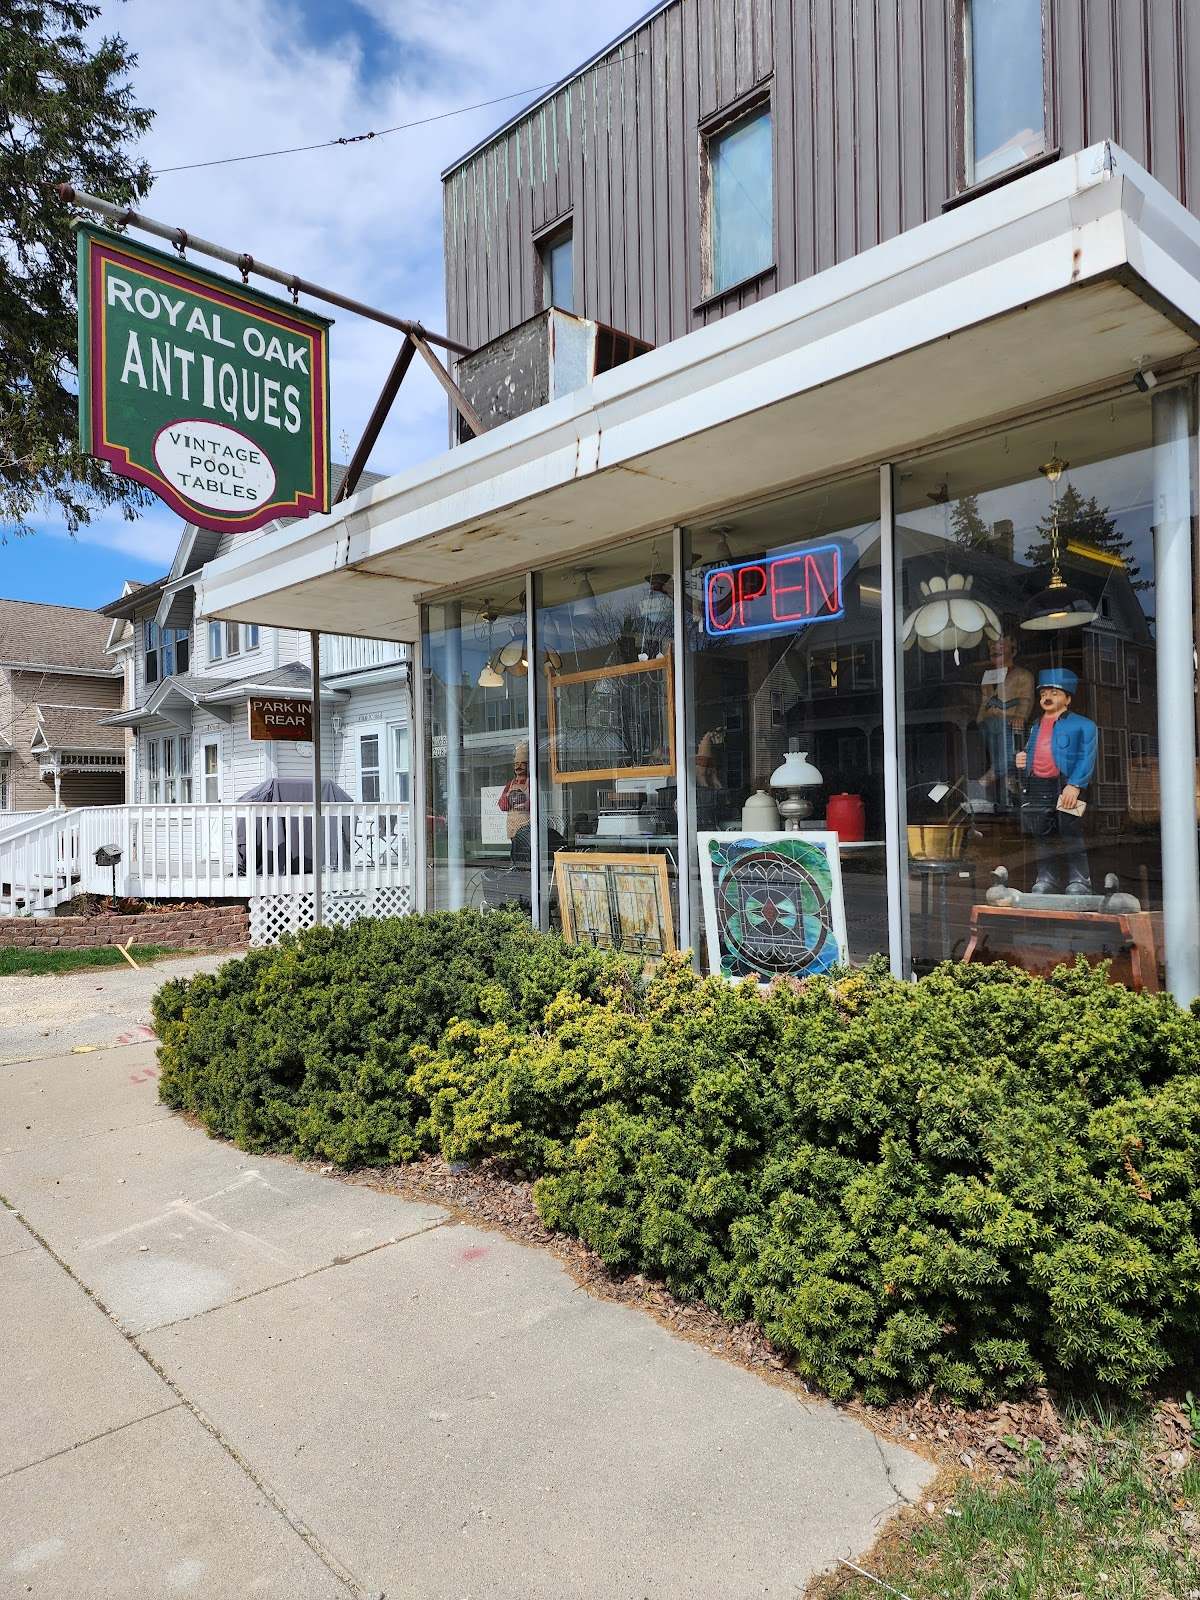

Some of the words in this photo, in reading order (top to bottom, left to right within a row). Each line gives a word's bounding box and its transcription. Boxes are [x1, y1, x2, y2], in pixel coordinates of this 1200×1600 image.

[107, 275, 235, 349] ROYAL
[243, 327, 310, 375] OAK
[120, 330, 302, 434] ANTIQUES
[169, 432, 261, 465] VINTAGE
[190, 456, 244, 479] POOL
[177, 472, 258, 501] TABLES
[708, 551, 839, 630] OPEN
[253, 701, 294, 713] PARK
[297, 703, 312, 714] IN
[264, 714, 306, 726] REAR
